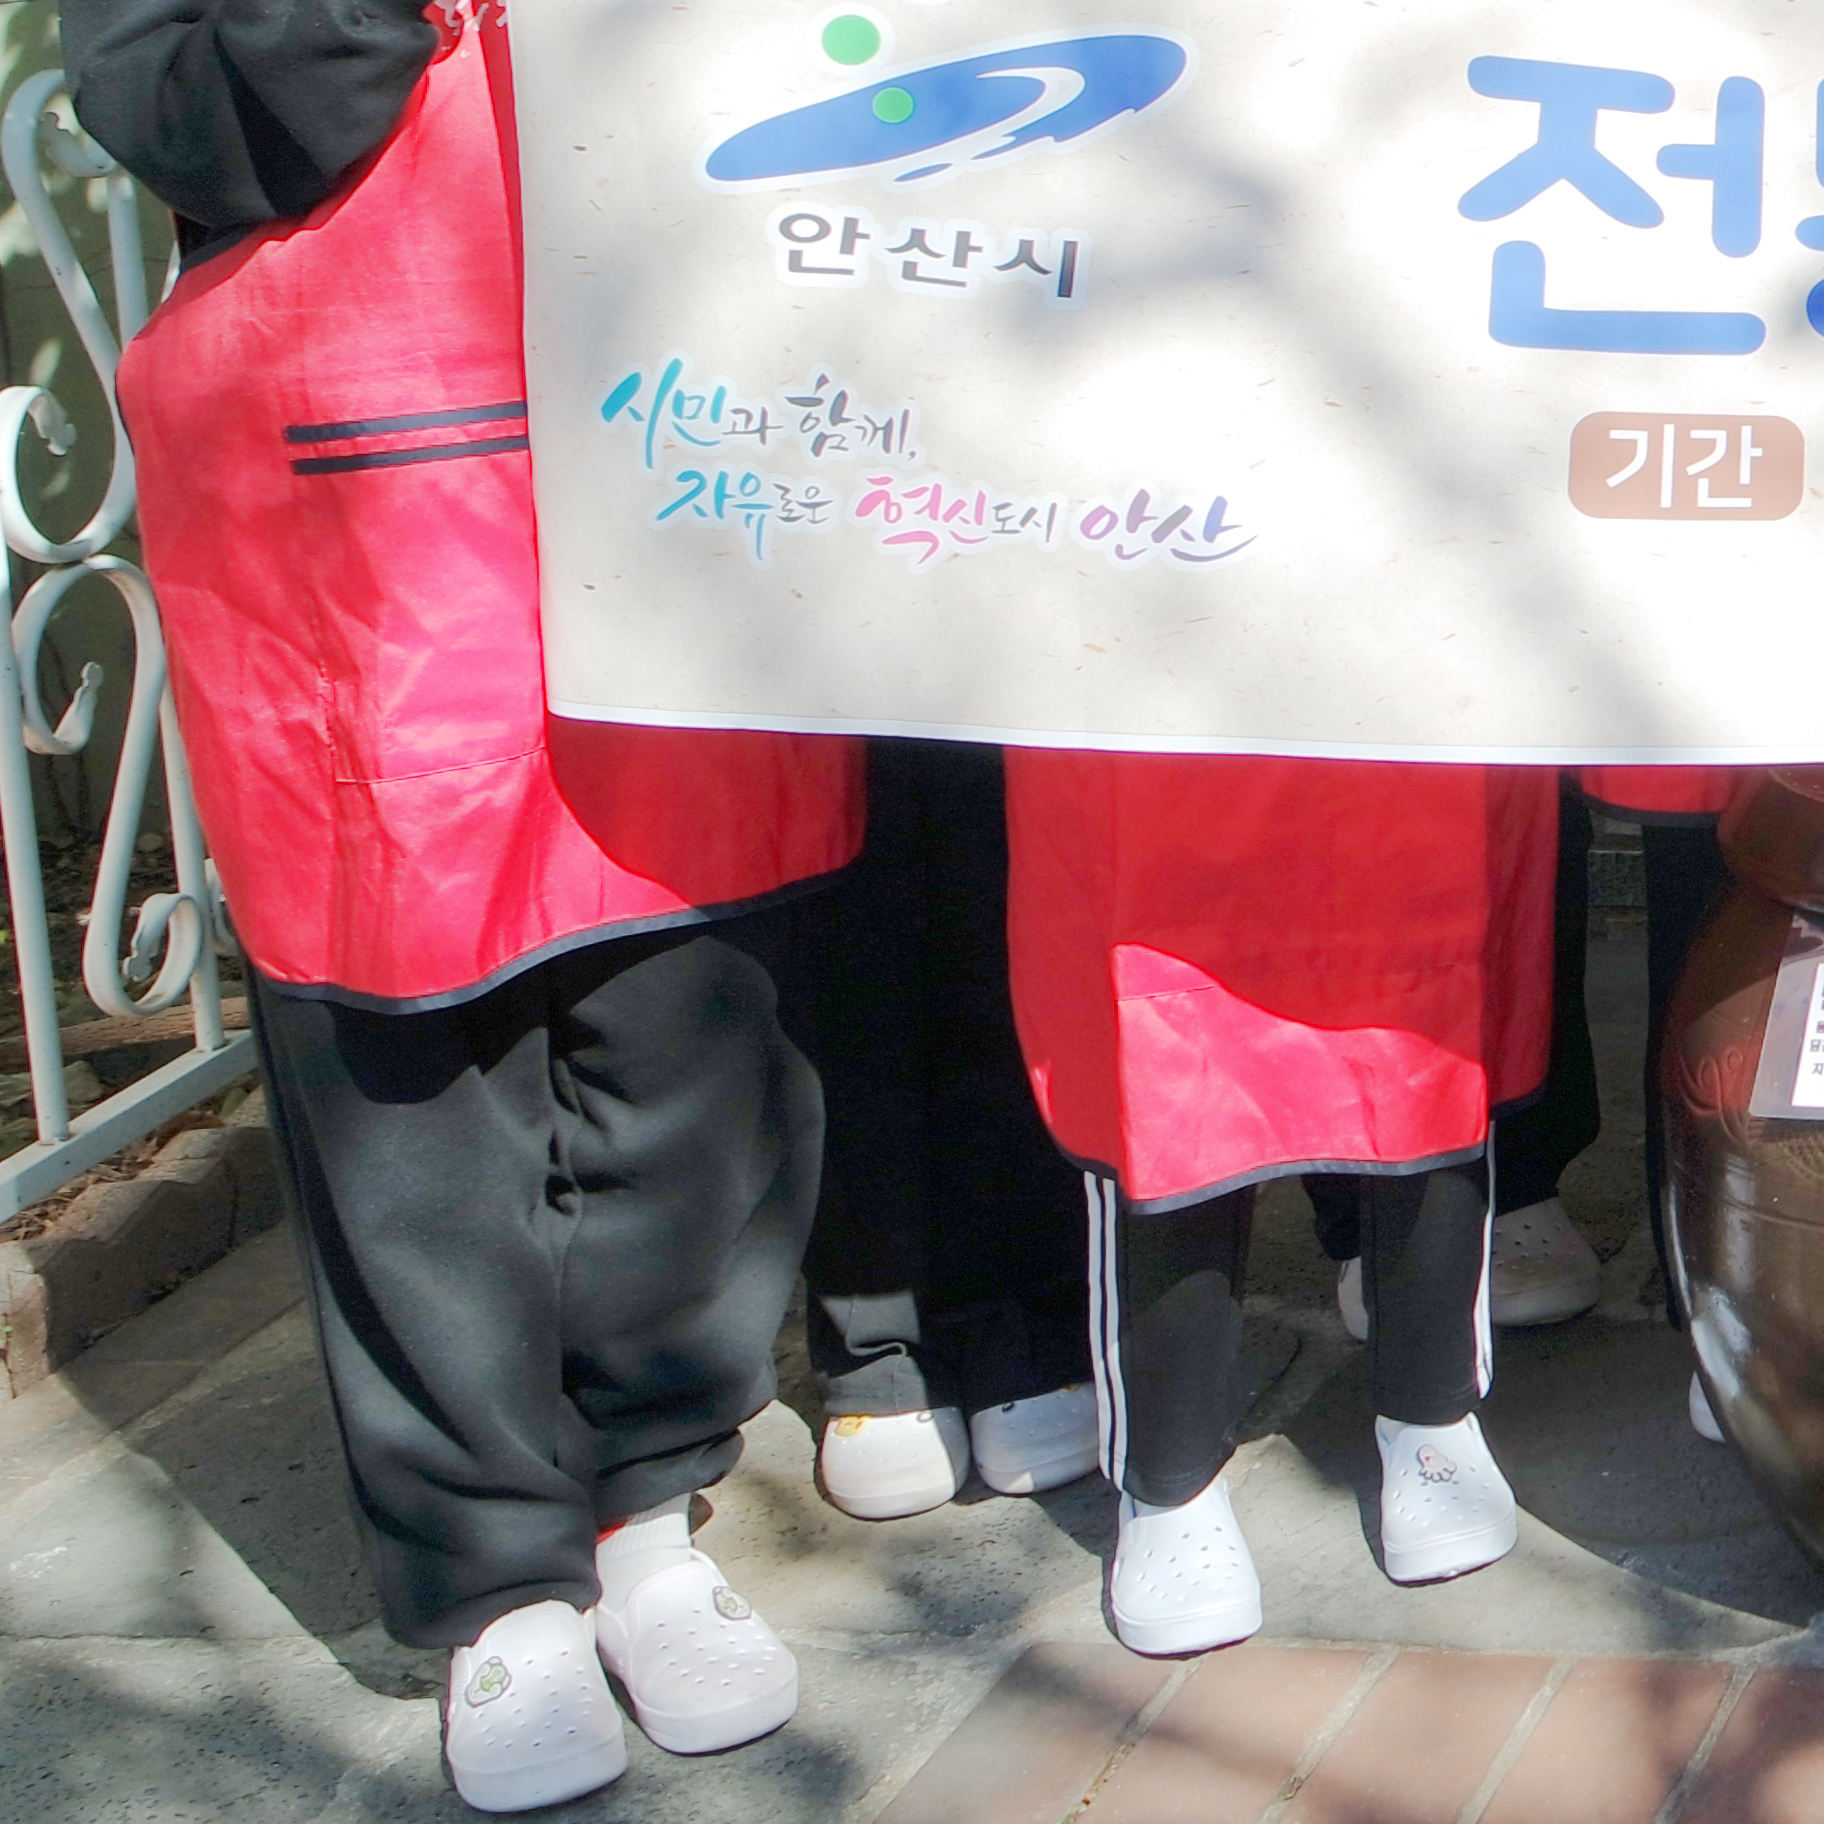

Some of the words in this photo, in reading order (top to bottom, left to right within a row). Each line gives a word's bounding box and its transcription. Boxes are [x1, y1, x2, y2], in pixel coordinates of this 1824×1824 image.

[779, 212, 1079, 300] 안산시
[600, 357, 784, 470] 시민과
[1604, 423, 1764, 509] 기간
[656, 470, 834, 563] 자유로운
[854, 476, 1059, 565] 혁신도시
[1079, 488, 1258, 564] 안산
[1812, 1062, 1824, 1075] 지
